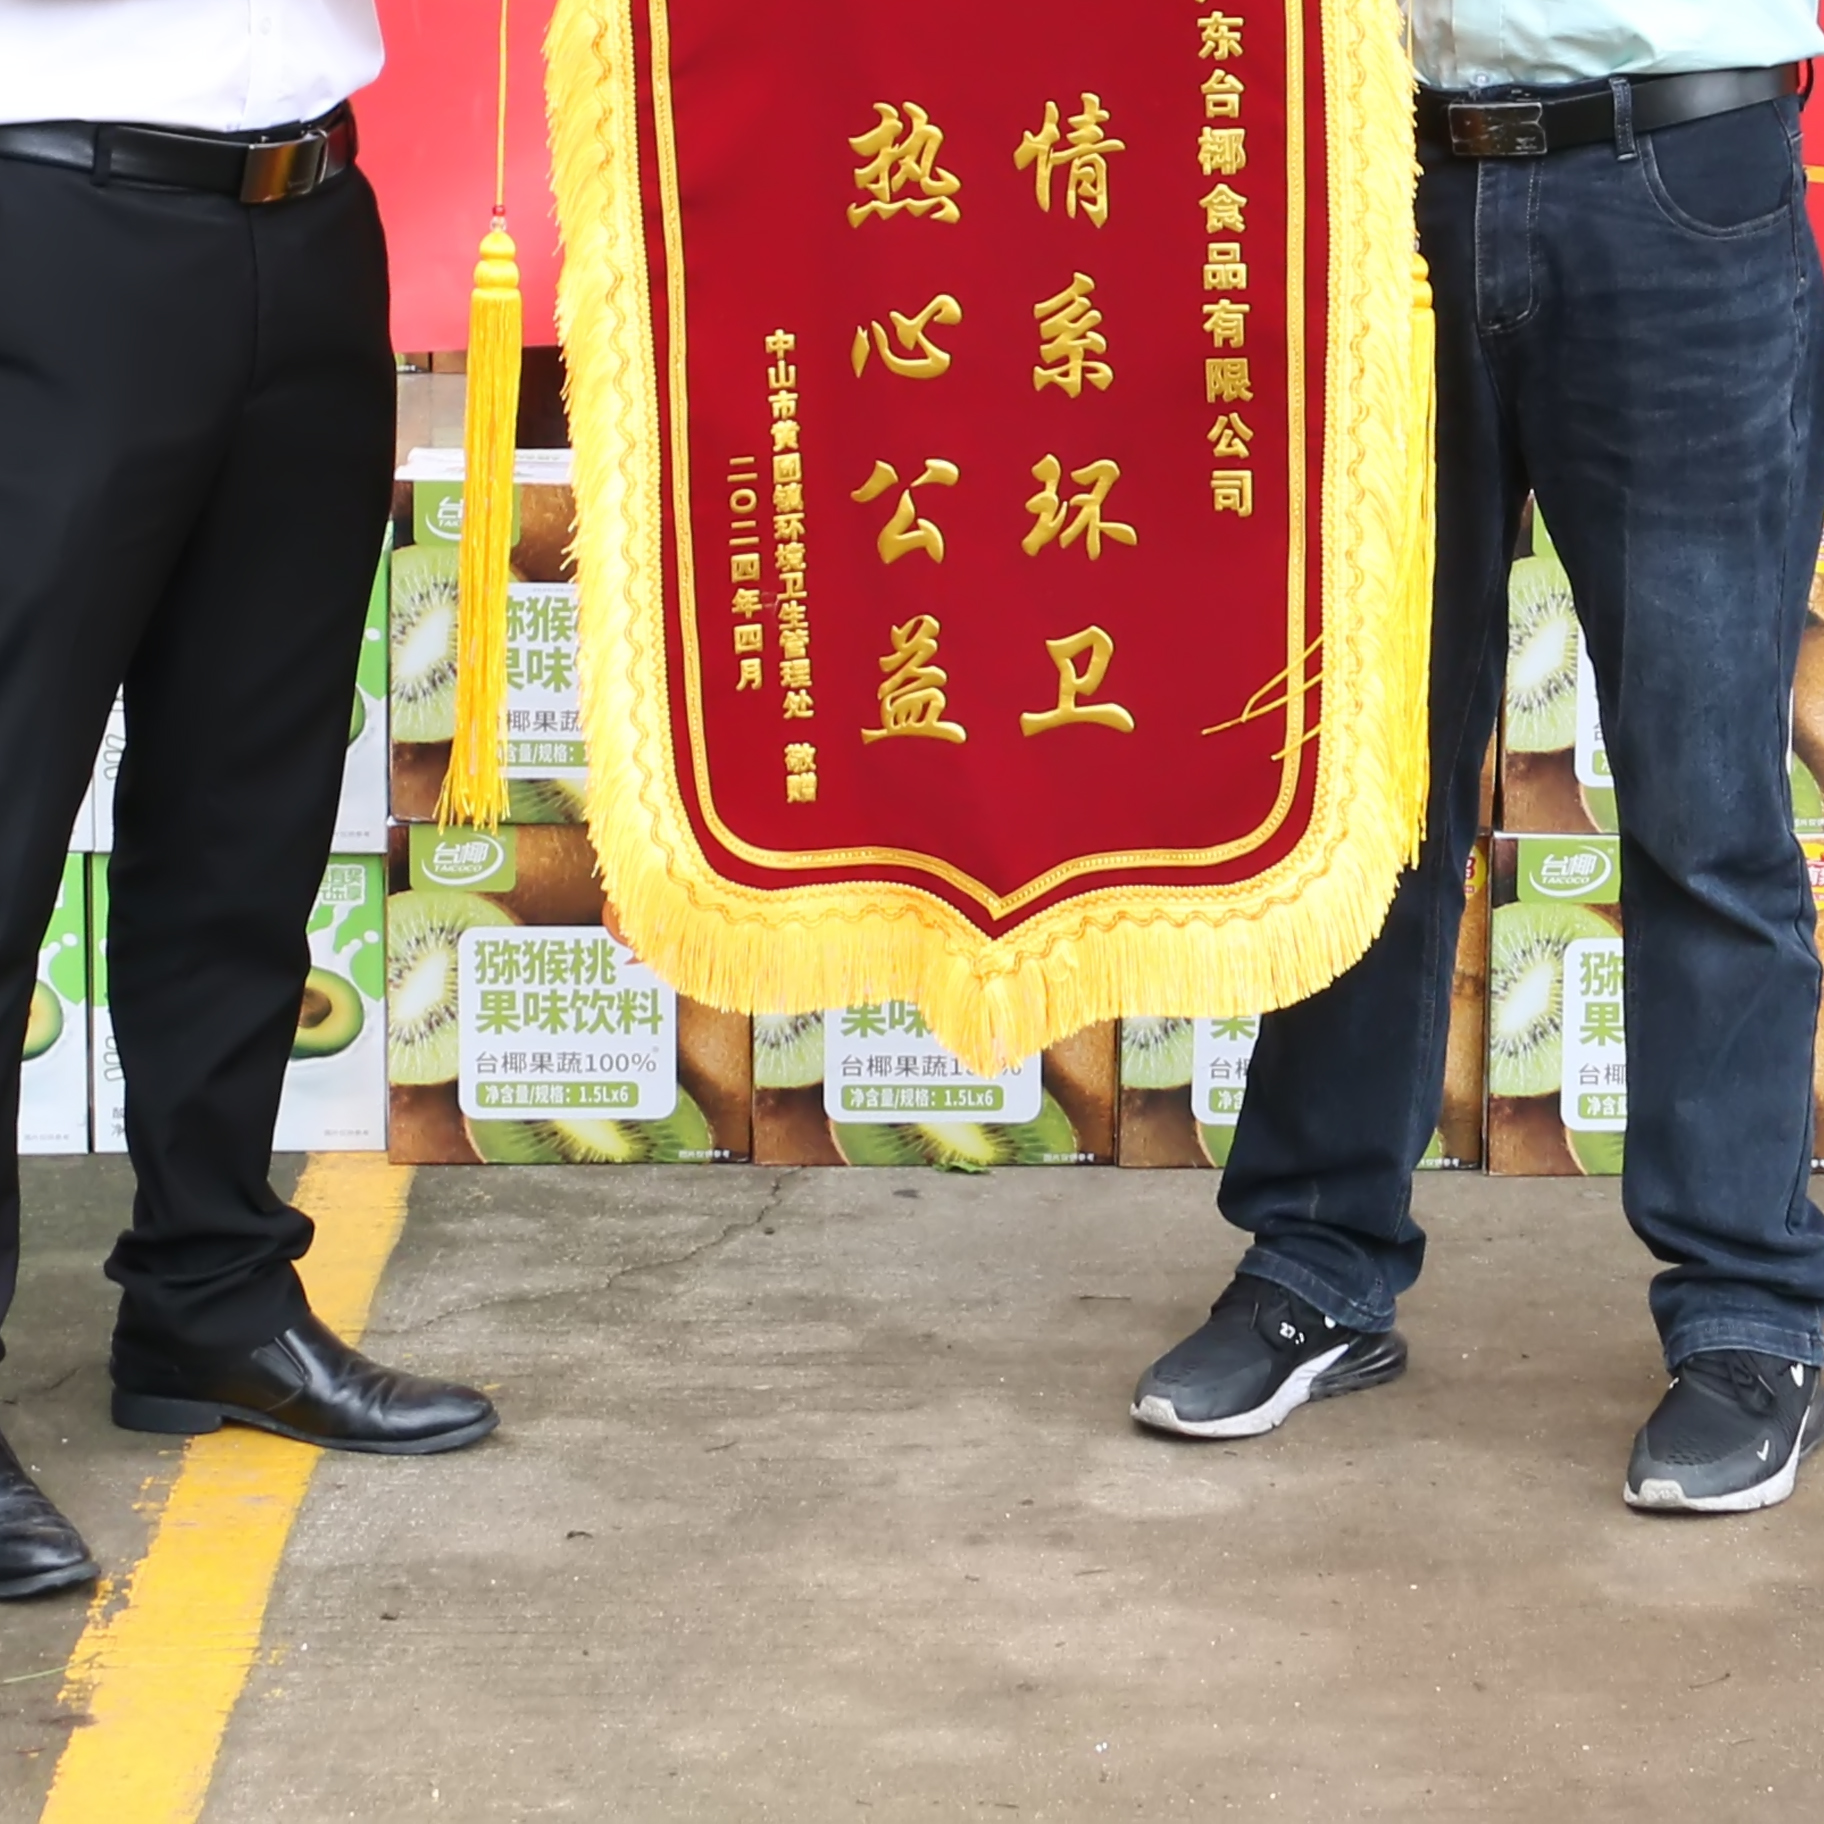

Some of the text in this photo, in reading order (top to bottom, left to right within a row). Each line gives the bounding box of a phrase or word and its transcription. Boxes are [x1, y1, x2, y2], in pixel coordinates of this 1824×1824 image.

[847, 101, 968, 744] 热心公益
[1013, 92, 1139, 738] 情系环卫
[433, 840, 488, 864] 台椰
[434, 864, 483, 873] TAICOCO
[1541, 853, 1597, 876] 台椰
[1541, 876, 1591, 885] TAICOCO
[473, 938, 617, 986] 猕猴桃
[473, 987, 664, 1036] 果味饮料
[475, 1049, 658, 1074] 台椰果蔬100%
[484, 1083, 630, 1105] 净含量/规格：1.5Lx6
[849, 1088, 995, 1109] 净含量/规格：1.5Lx6
